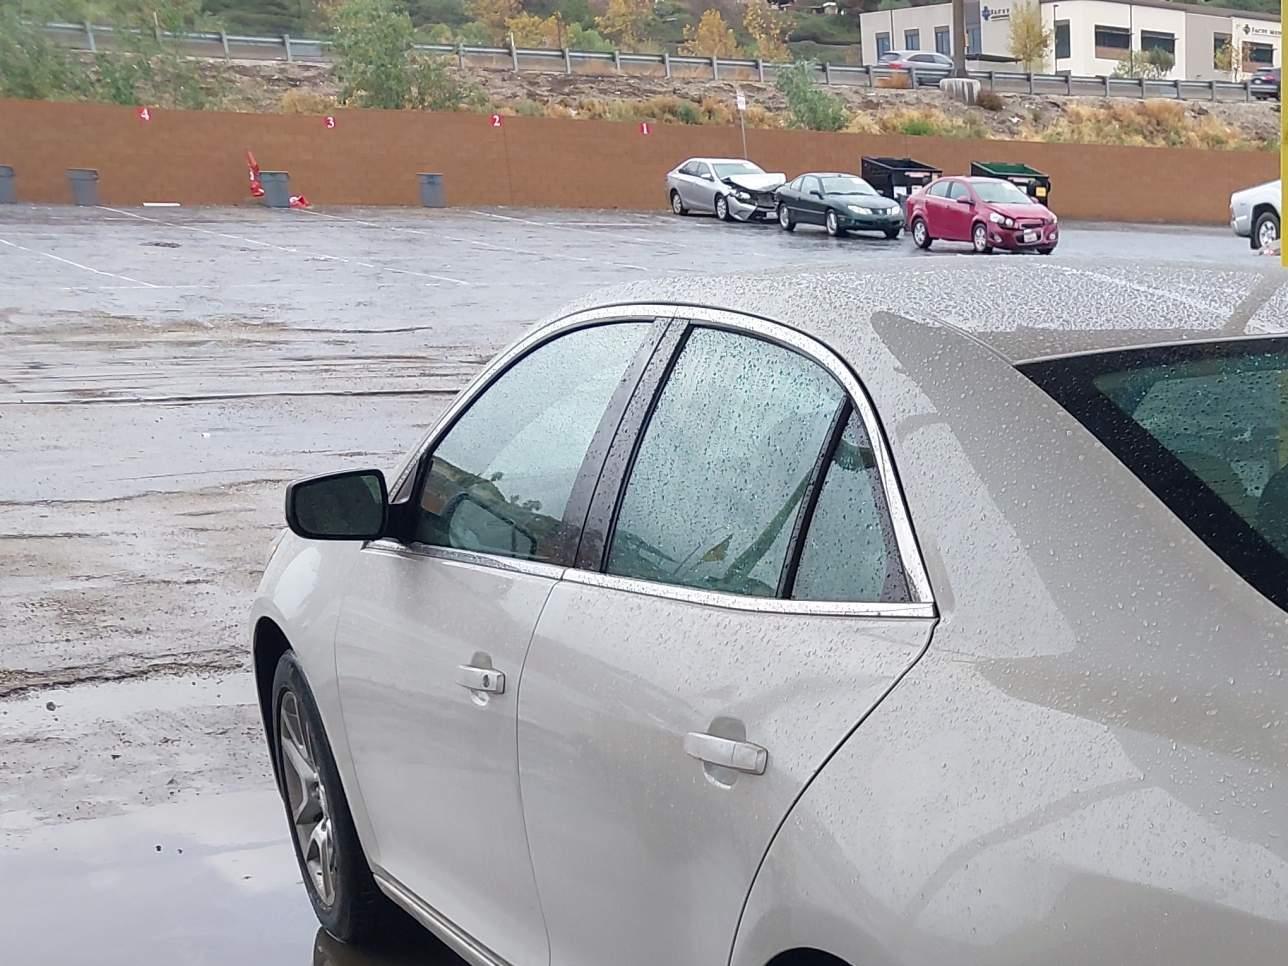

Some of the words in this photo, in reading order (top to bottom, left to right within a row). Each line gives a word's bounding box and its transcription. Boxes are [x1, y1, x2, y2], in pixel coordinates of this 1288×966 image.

[140, 108, 150, 121] 4
[492, 114, 501, 127] 2
[327, 116, 335, 129] 3
